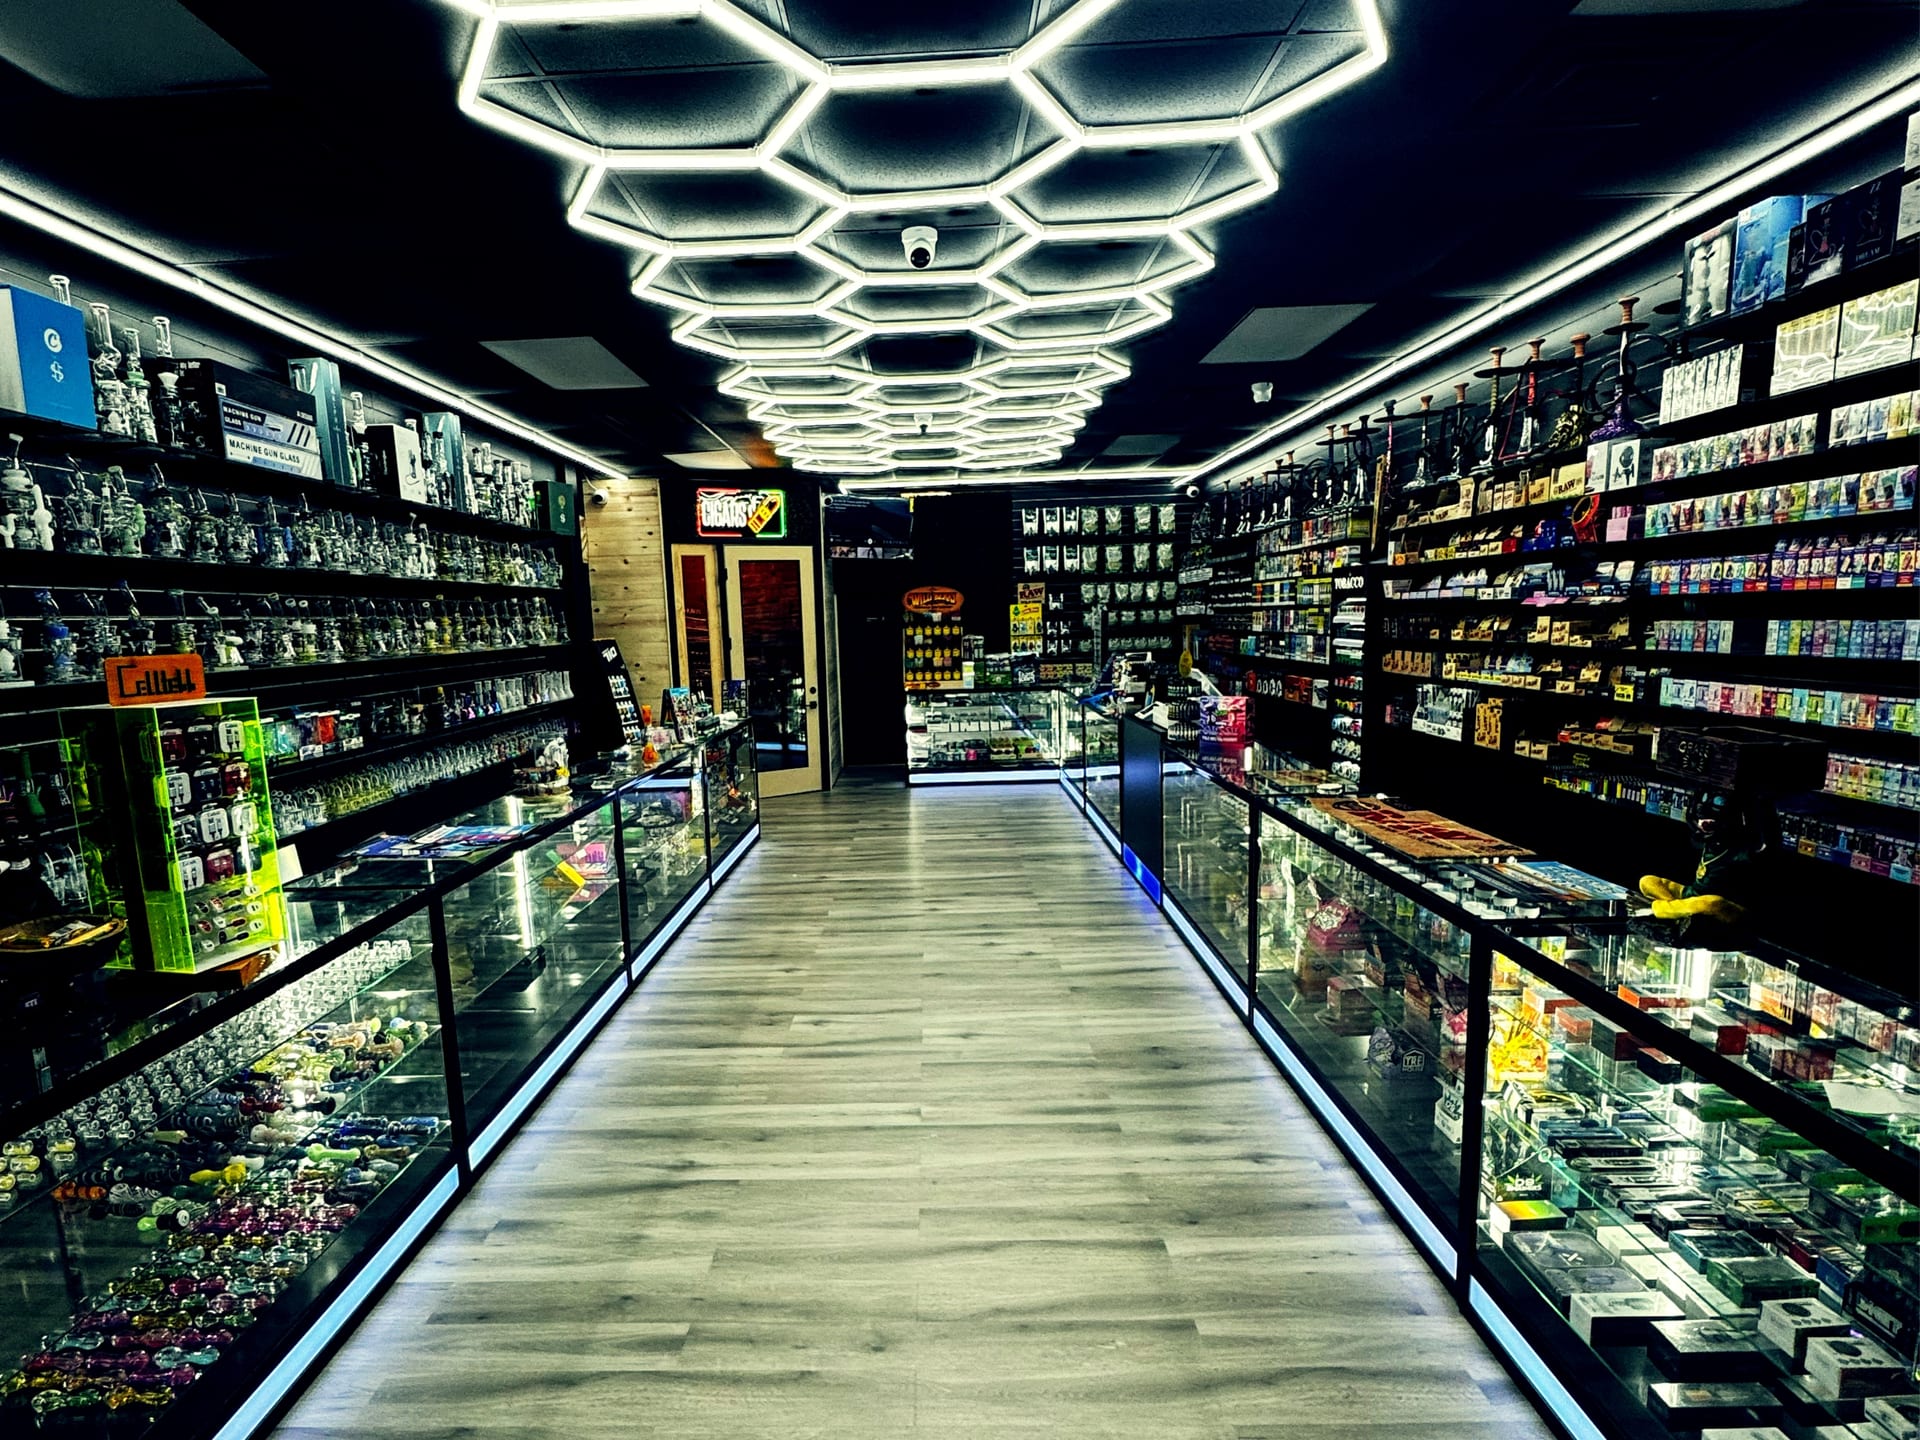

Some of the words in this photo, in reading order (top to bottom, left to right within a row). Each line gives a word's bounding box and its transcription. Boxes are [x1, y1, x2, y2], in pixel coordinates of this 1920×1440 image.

[223, 406, 249, 419] MACHINE
[250, 412, 262, 422] GUN
[225, 417, 242, 427] GLASS
[229, 439, 262, 454] MACHINE
[263, 447, 278, 459] GUN
[279, 451, 300, 464] GLASS
[1558, 479, 1576, 495] RAW
[701, 499, 747, 528] CIGARS
[1019, 587, 1044, 600] RAW
